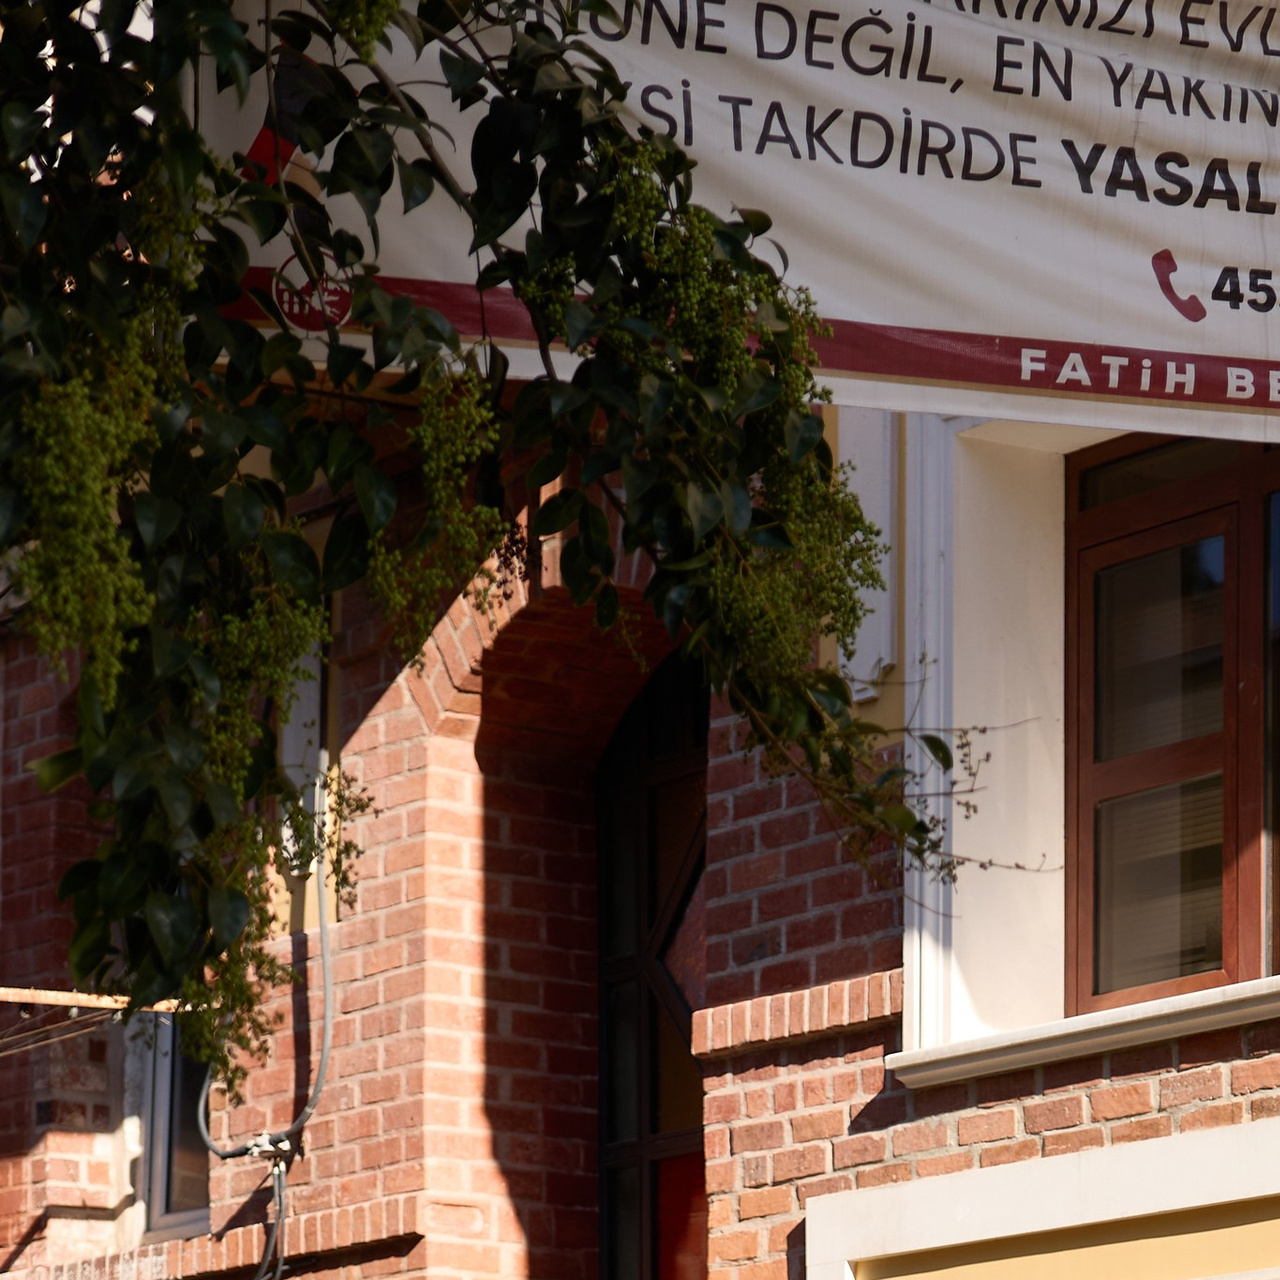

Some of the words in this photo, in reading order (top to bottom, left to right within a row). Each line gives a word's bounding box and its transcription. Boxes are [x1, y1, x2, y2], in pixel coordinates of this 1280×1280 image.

[754, 2, 964, 94] DEĞİL,
[993, 34, 1073, 102] EN
[1098, 55, 1280, 128] YAKIN
[718, 94, 1042, 188] TAKDİRDE
[1061, 138, 1277, 216] YASAL
